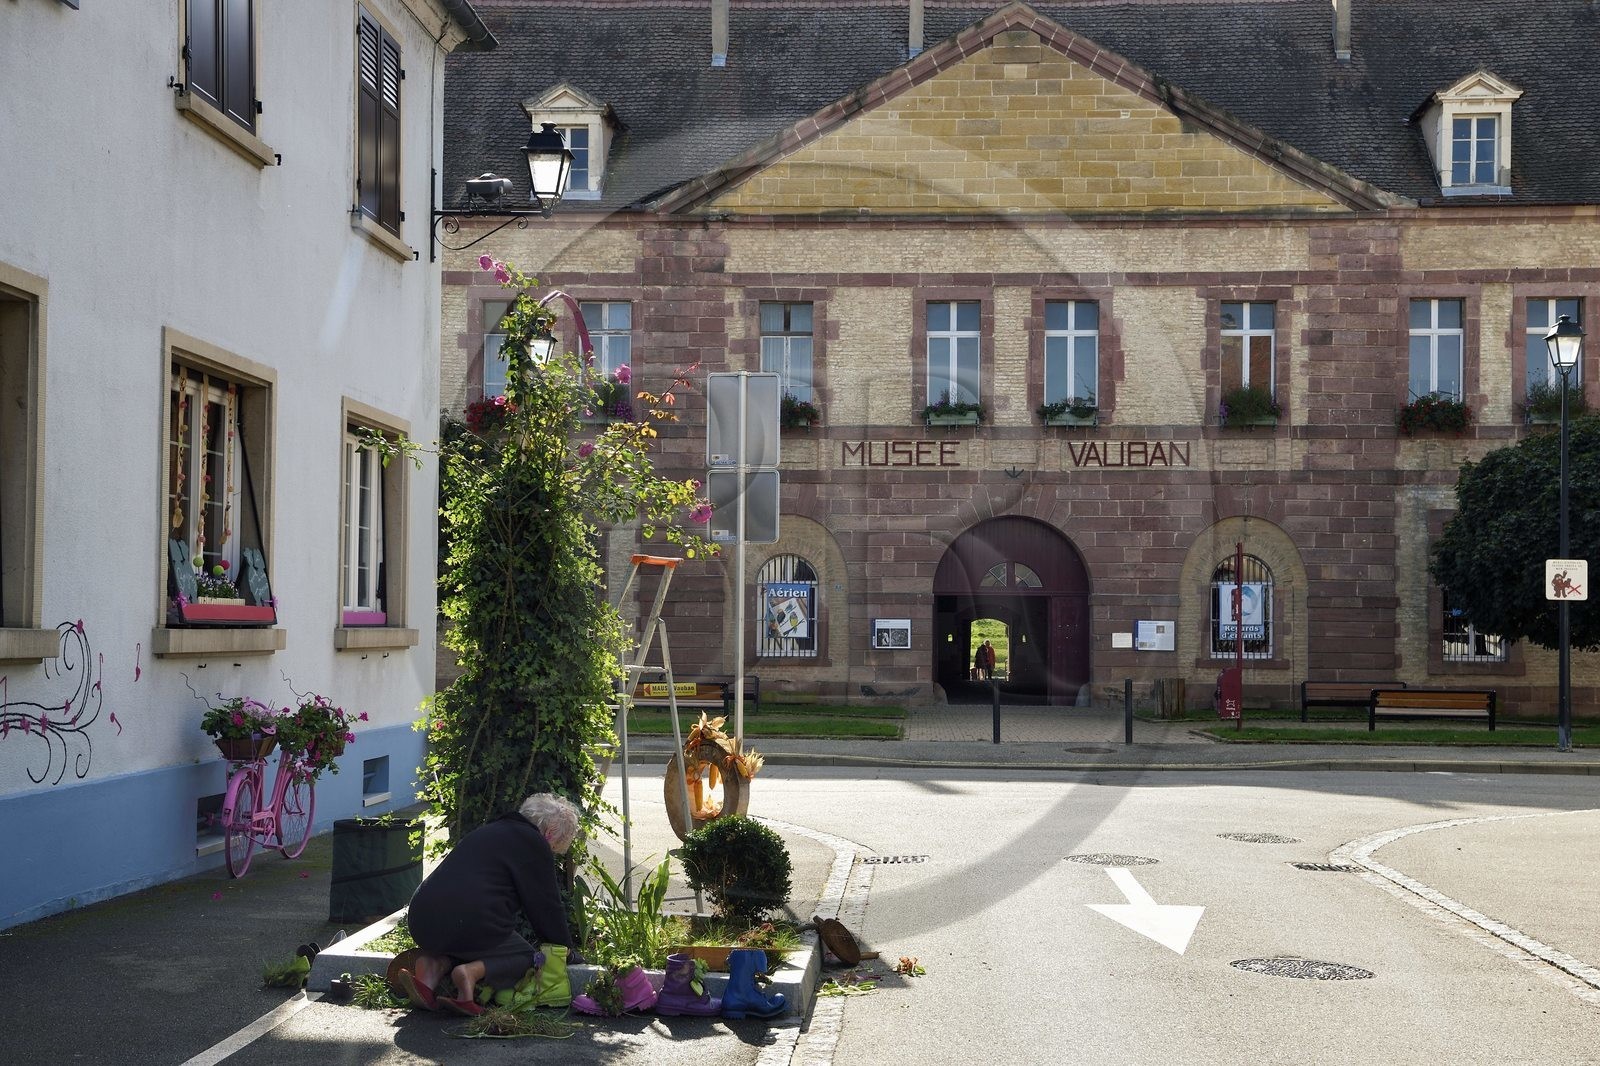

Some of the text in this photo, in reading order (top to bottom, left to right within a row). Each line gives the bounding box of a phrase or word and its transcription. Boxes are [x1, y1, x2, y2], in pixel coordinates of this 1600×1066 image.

[841, 441, 1190, 467] MUSEE VAUBAN
[768, 588, 808, 598] Aérien
